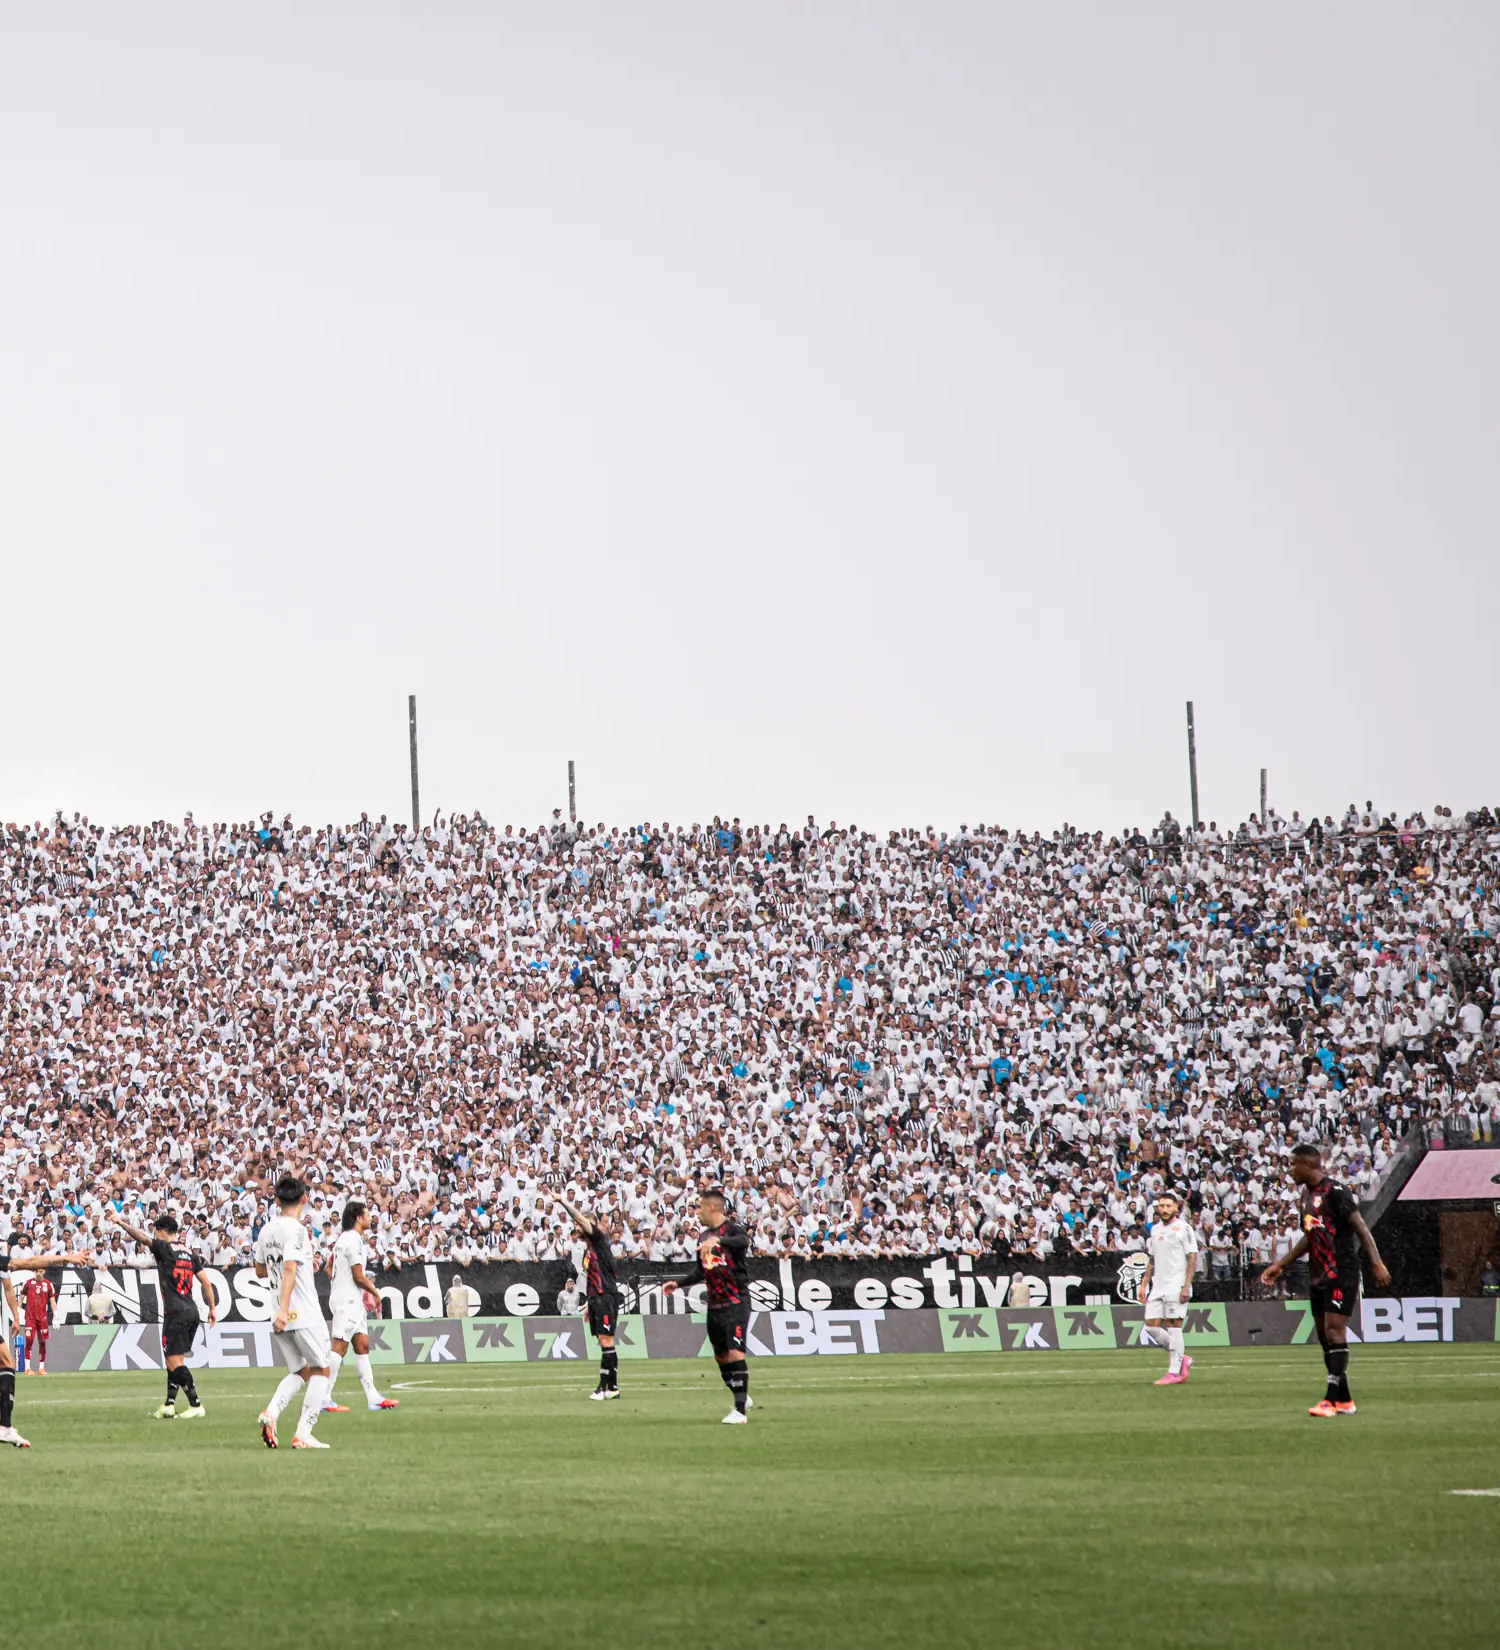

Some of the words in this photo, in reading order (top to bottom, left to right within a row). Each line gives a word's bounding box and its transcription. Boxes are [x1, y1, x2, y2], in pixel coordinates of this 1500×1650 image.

[172, 1267, 194, 1295] 77
[504, 1283, 541, 1316] e
[947, 1311, 991, 1339] 7K
[1007, 1321, 1051, 1348] 7K
[1063, 1311, 1105, 1337] 7K
[1285, 1296, 1461, 1345] 7BET
[411, 1334, 457, 1363] 7K
[472, 1323, 516, 1349] 7K
[534, 1331, 579, 1359] 7K
